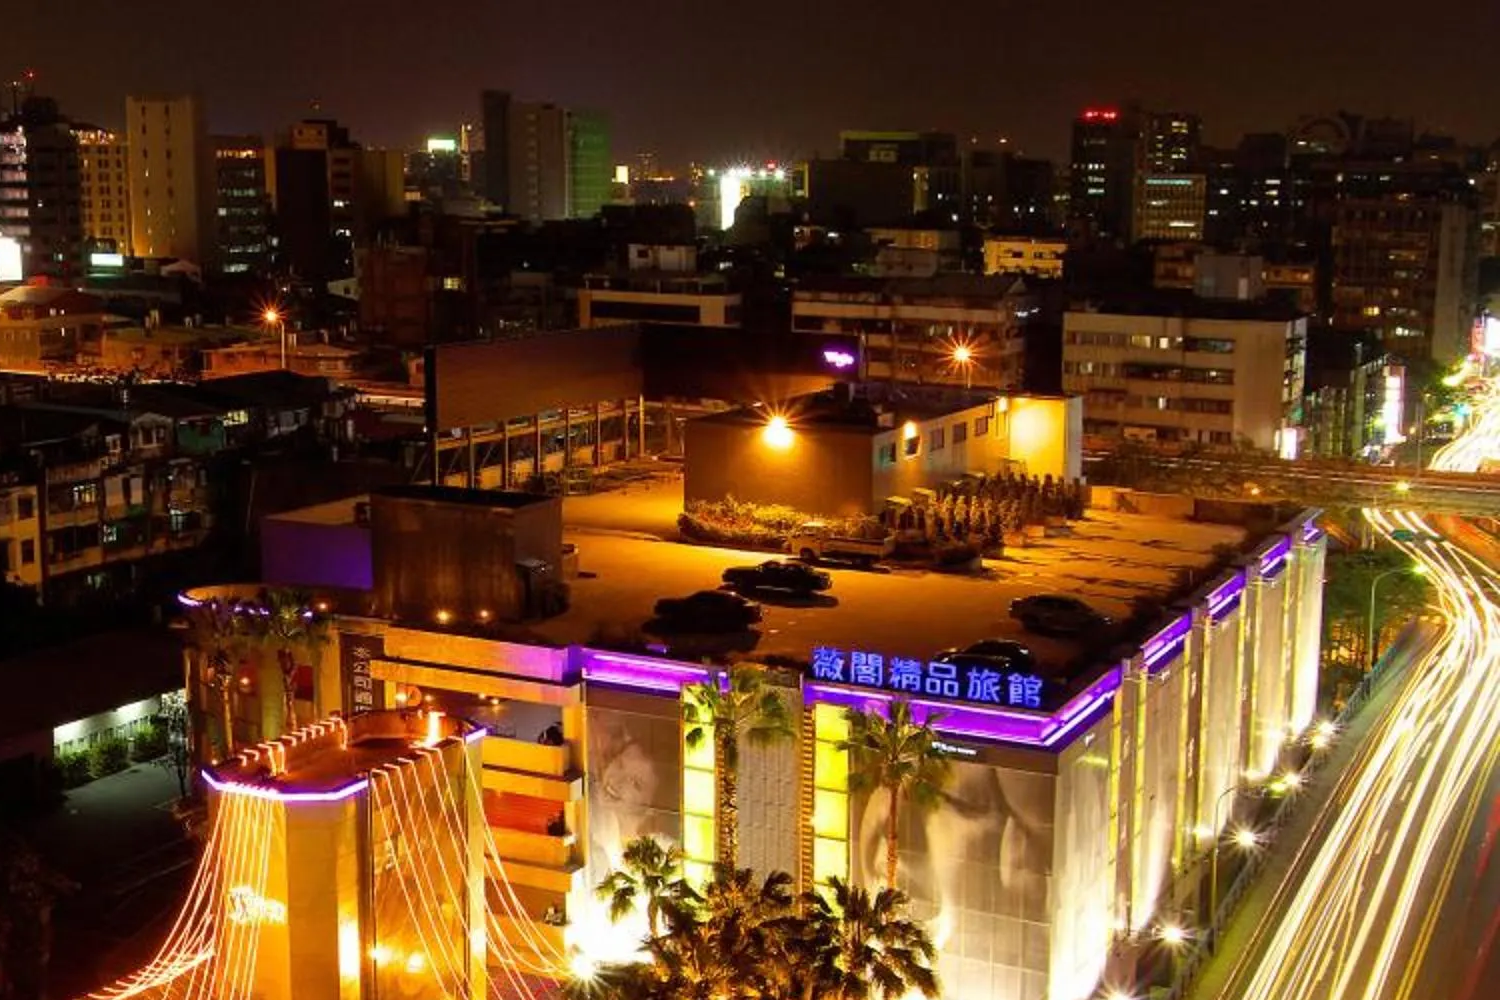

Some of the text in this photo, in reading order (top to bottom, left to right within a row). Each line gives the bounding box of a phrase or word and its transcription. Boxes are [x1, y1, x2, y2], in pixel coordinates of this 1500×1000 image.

[812, 646, 1044, 707] 薇閣精品旅館
